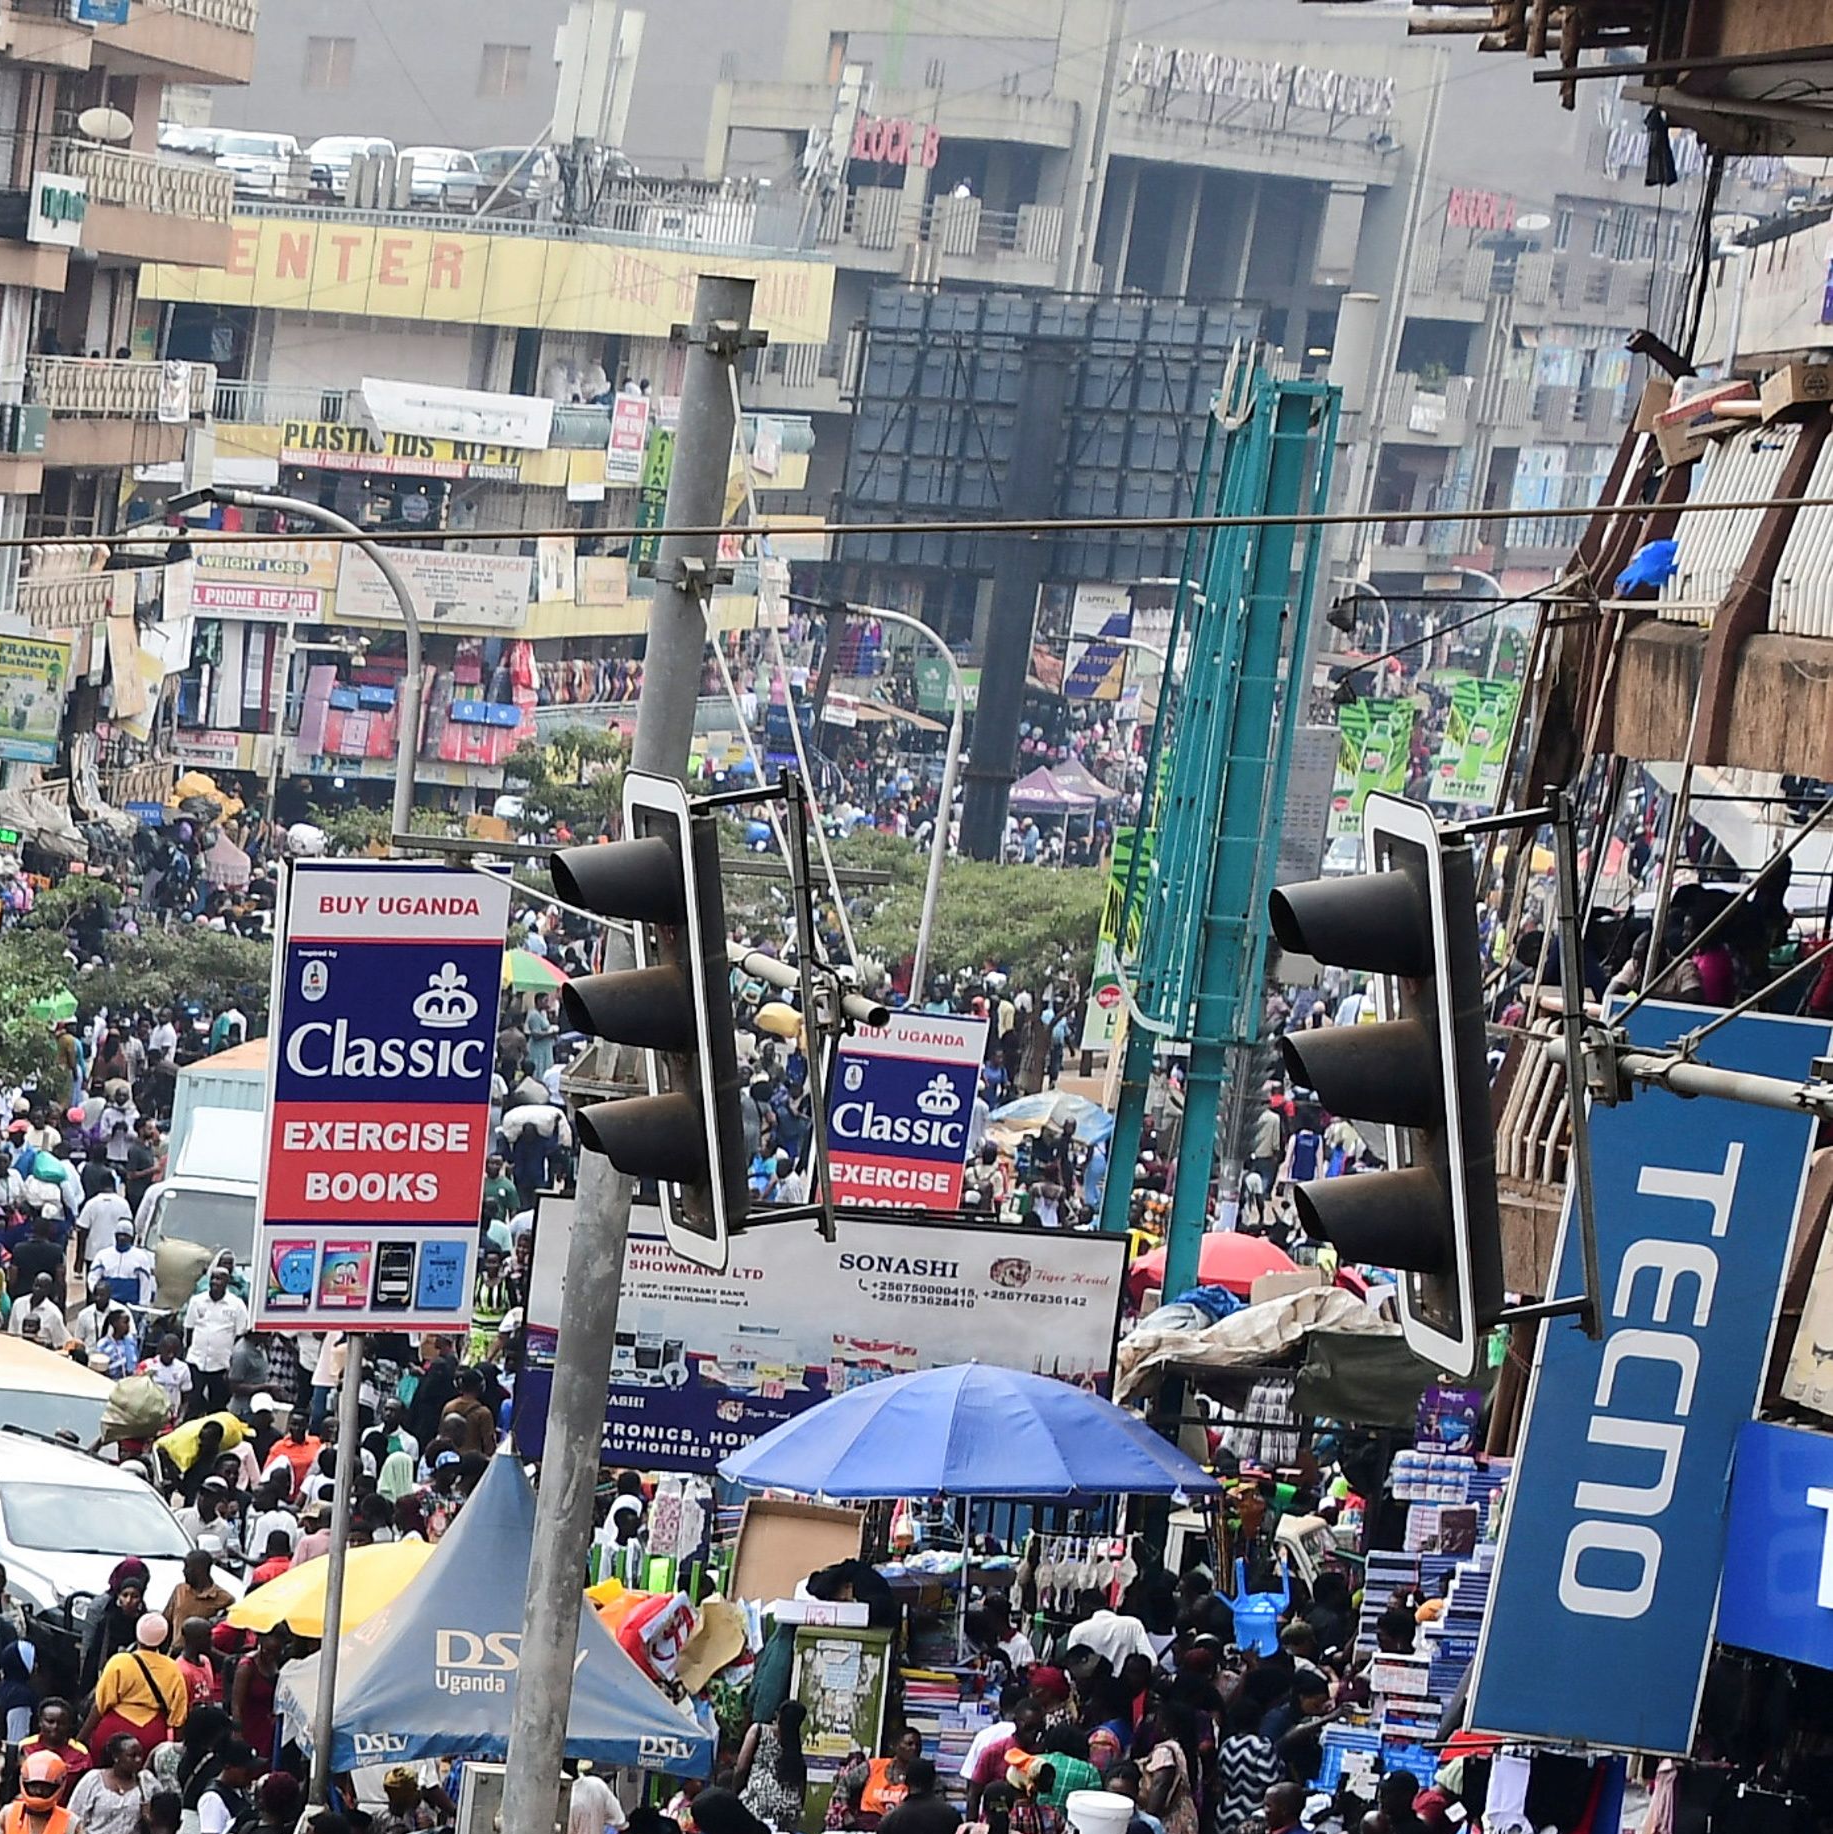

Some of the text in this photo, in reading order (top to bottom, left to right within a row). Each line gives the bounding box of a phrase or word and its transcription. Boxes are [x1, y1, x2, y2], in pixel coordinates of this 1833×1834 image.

[201, 555, 305, 575] WEIGHT LOSS
[481, 557, 526, 572] TOUCH
[206, 589, 314, 610] PHONE REPAIR
[319, 895, 480, 917] BUY UGANDA
[859, 1025, 966, 1048] BUY UGANDA
[285, 1018, 485, 1079] Classic
[831, 1101, 965, 1149] Classic
[282, 1121, 471, 1153] EXERCISE
[304, 1171, 440, 1203] BOOKS
[829, 1162, 952, 1194] EXERCISE
[733, 1268, 764, 1281] LTD
[839, 1253, 960, 1279] SONASHI
[1033, 1268, 1066, 1284] Tiger
[663, 1284, 746, 1298] CENTENARY BANK
[674, 1293, 718, 1305] BUILDING
[601, 1439, 712, 1459] AUTHORISED
[435, 1669, 506, 1696] Uganda
